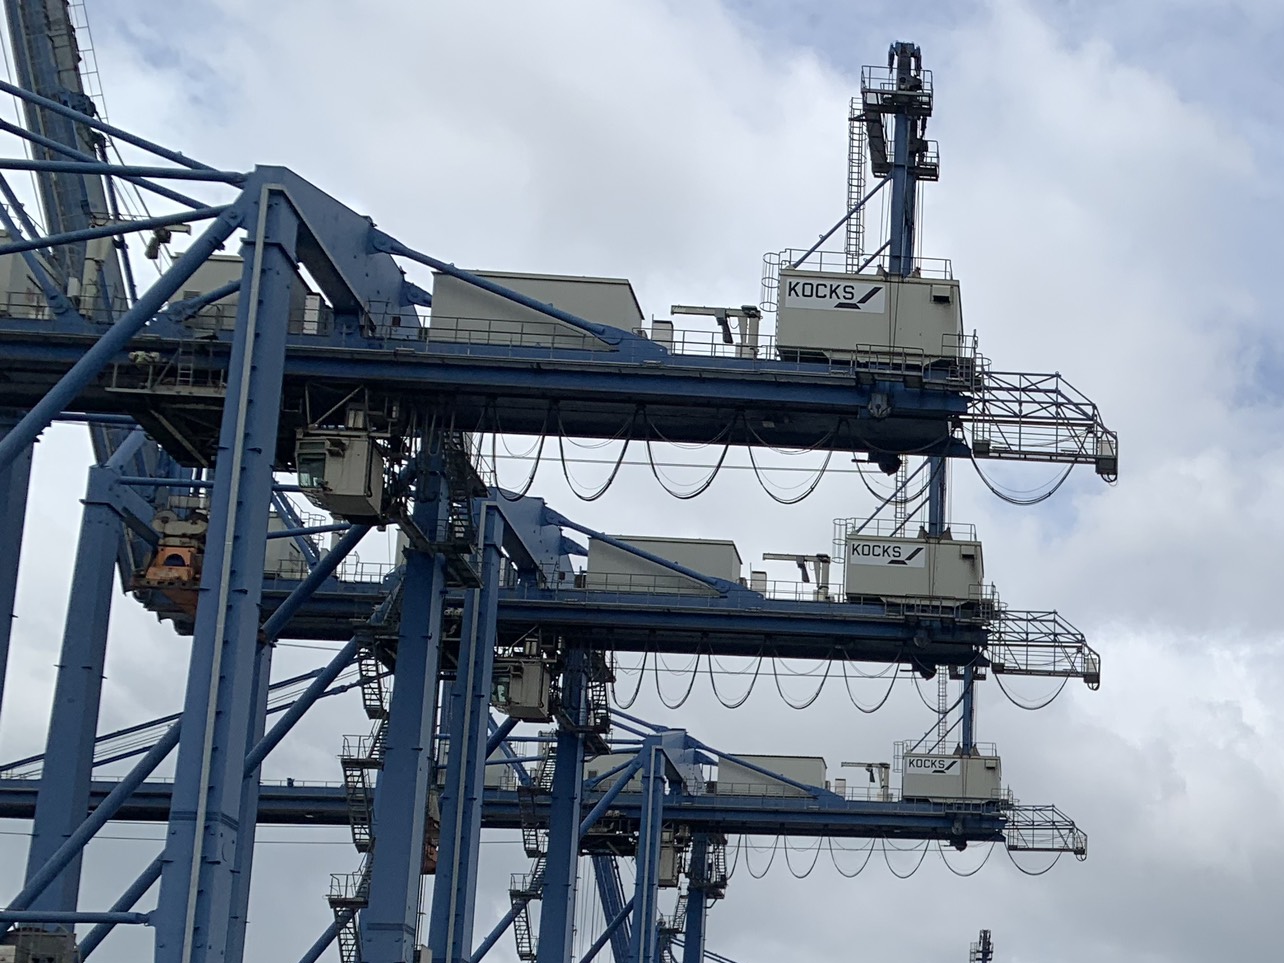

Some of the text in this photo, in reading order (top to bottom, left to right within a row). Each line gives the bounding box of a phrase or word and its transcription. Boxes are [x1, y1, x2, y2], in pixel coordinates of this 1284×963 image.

[788, 281, 854, 300] KOCKS
[852, 543, 901, 558] KOCKS
[908, 758, 946, 769] KOCKS
